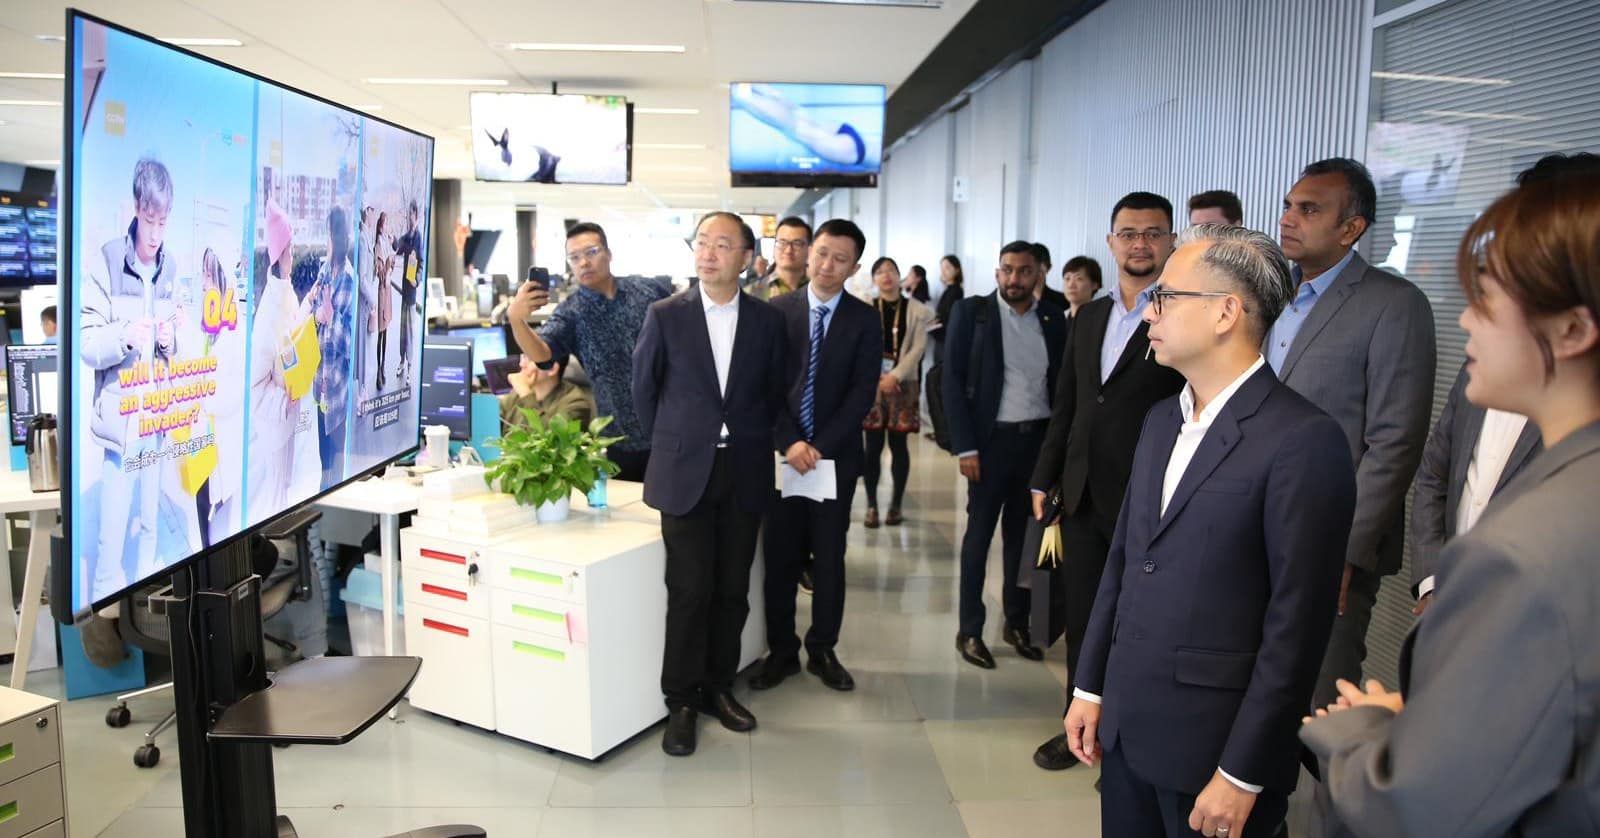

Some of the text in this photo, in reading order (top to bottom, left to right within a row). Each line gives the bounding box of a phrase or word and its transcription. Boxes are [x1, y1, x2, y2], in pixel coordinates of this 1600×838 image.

[119, 356, 217, 387] will it become
[119, 380, 216, 415] an aggressive
[139, 403, 200, 437] invader?
